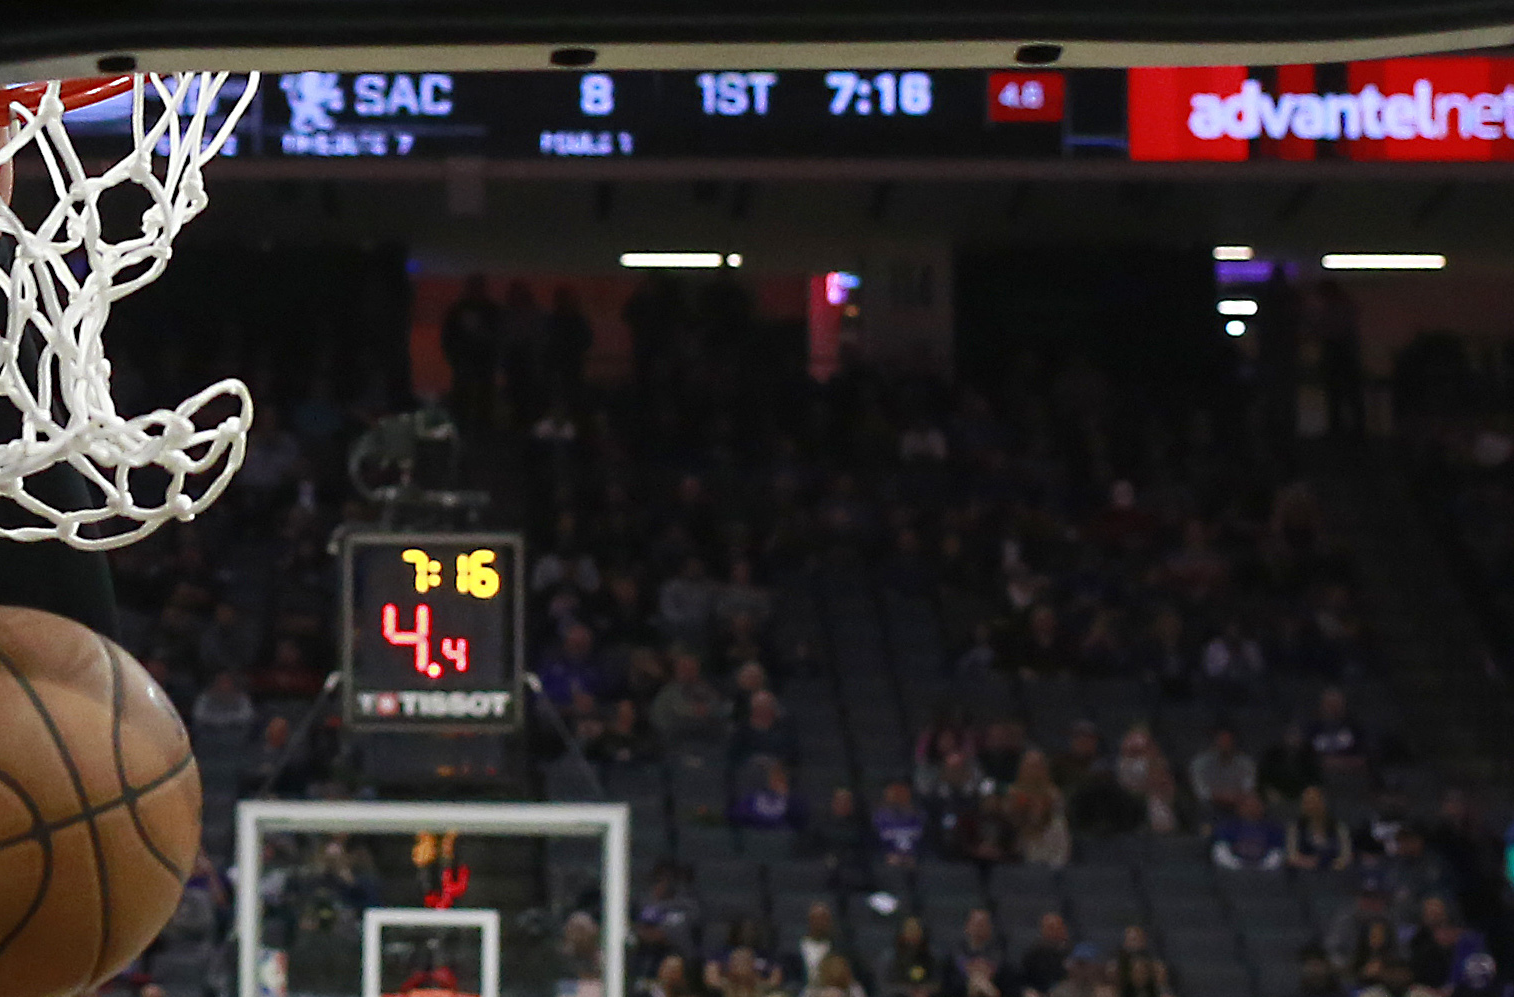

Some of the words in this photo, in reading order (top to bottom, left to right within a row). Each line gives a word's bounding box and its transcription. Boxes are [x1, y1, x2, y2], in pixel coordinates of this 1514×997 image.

[354, 72, 453, 116] SAC
[579, 73, 614, 116] 8
[696, 71, 778, 116] 1ST
[824, 71, 933, 116] 7:16
[400, 548, 502, 600] 7:16
